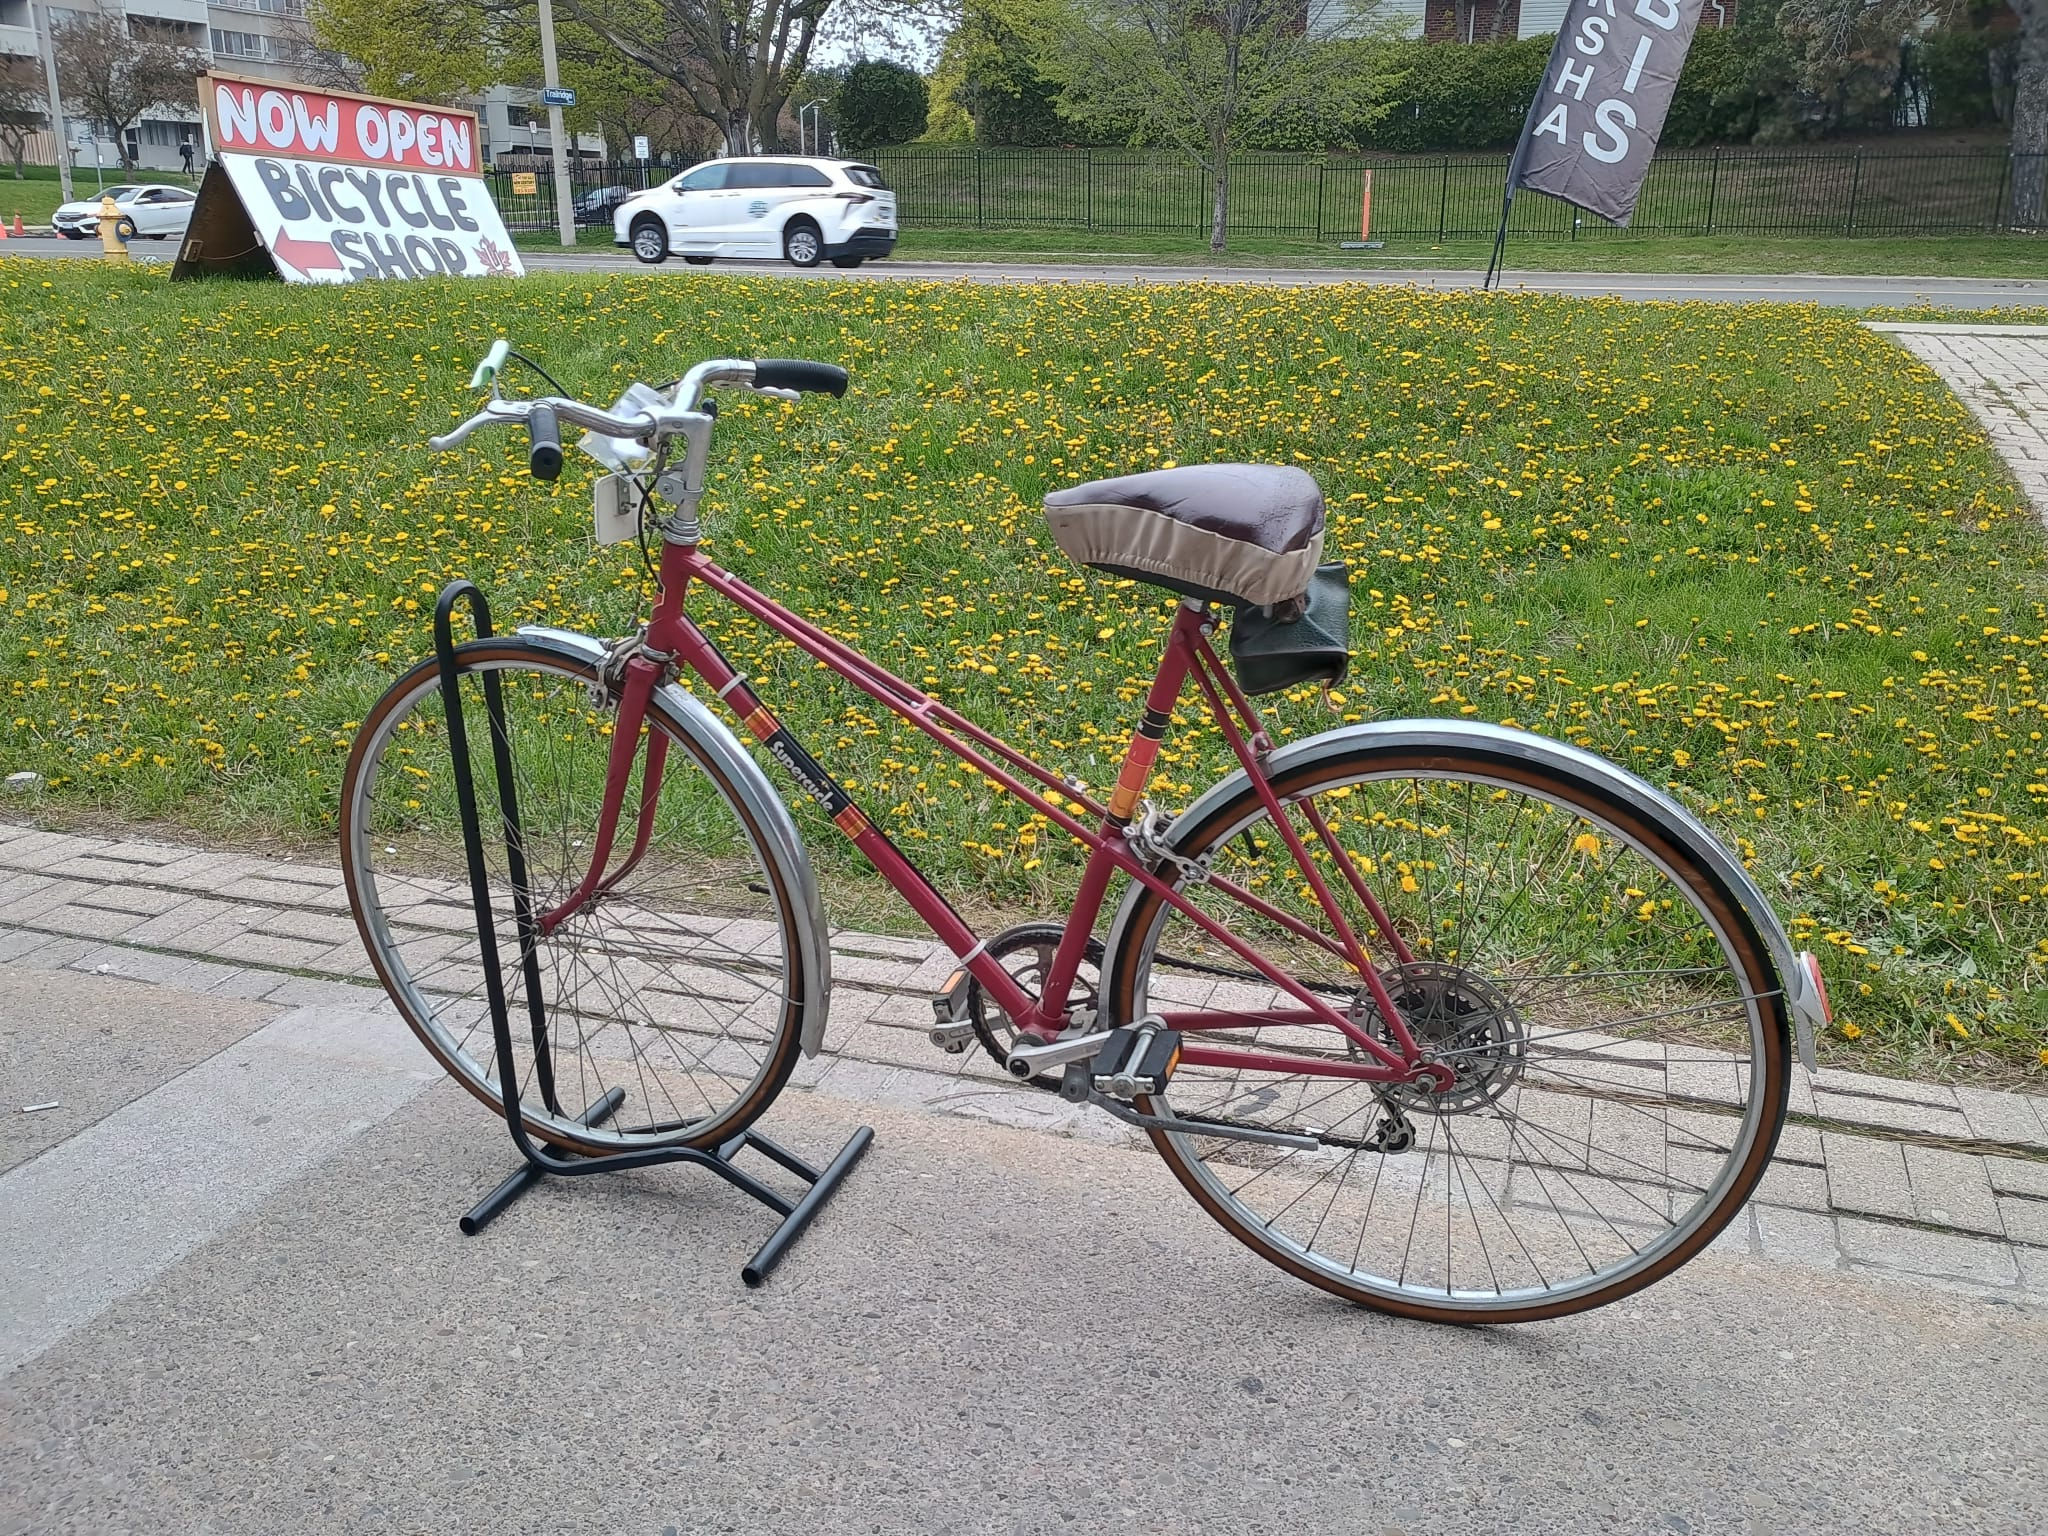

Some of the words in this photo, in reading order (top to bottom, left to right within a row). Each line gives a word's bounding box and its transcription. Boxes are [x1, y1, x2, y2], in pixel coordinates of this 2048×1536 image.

[215, 84, 339, 153] NOW
[355, 104, 471, 169] OPEN
[254, 158, 480, 232] BICYCLE
[330, 229, 467, 281] SHOP
[770, 740, 835, 812] Supercycle
